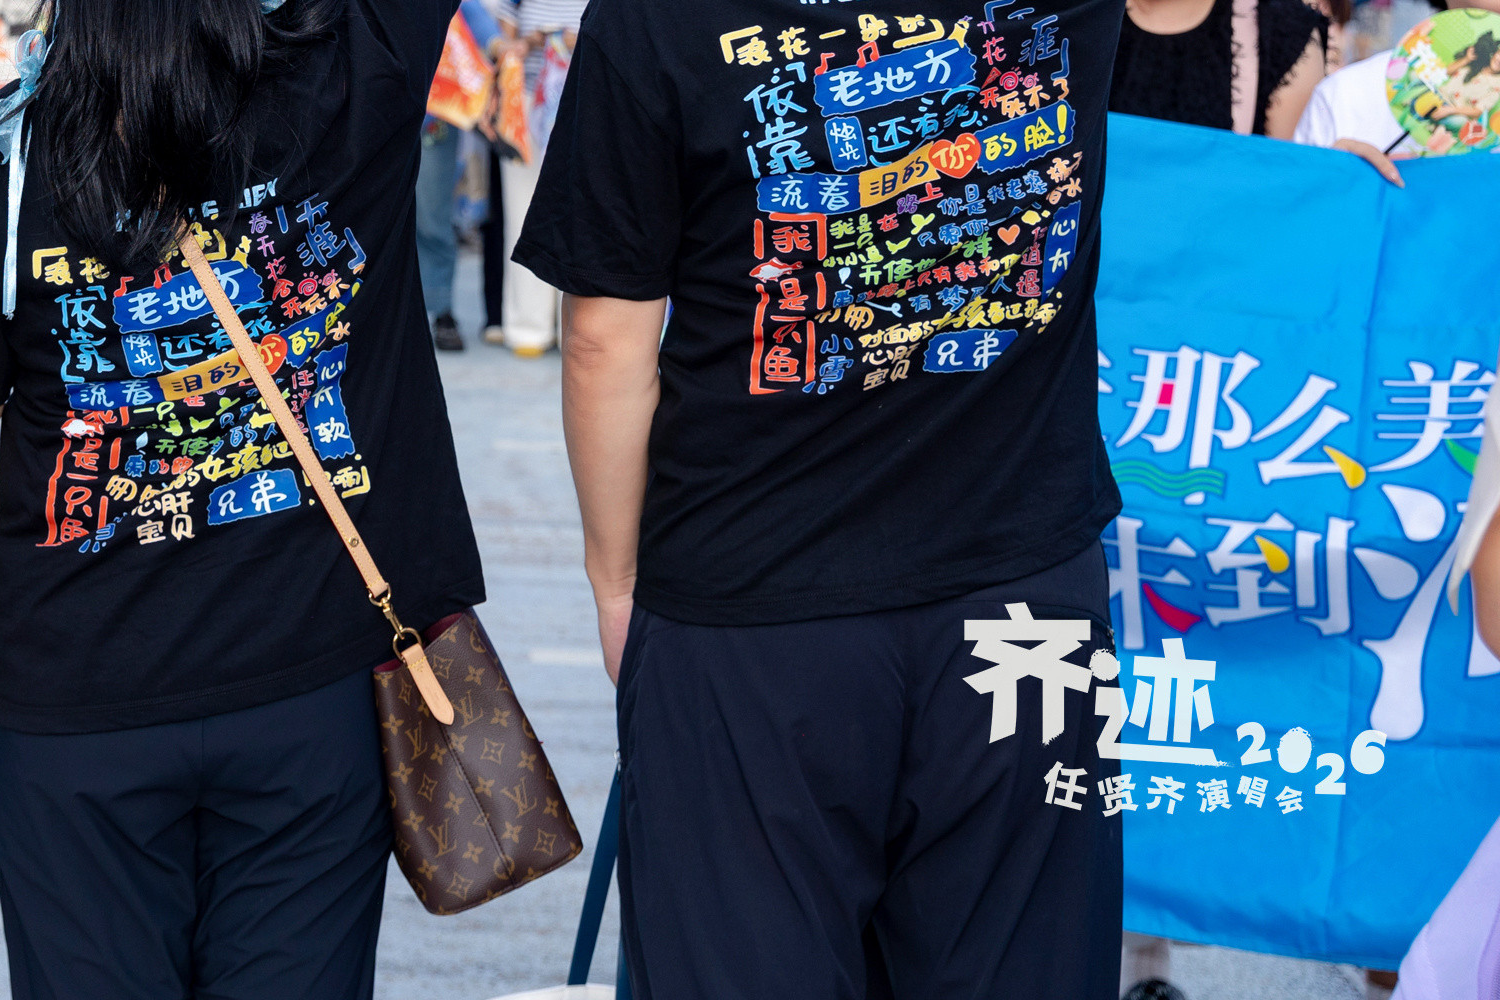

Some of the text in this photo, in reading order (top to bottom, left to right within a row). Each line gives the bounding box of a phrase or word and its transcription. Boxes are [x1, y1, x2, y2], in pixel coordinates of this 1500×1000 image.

[828, 47, 960, 107] 老地方
[937, 330, 1002, 371] 兄弟
[311, 360, 351, 444] 心太软
[218, 471, 288, 517] 兄弟
[137, 514, 196, 546] 宝贝
